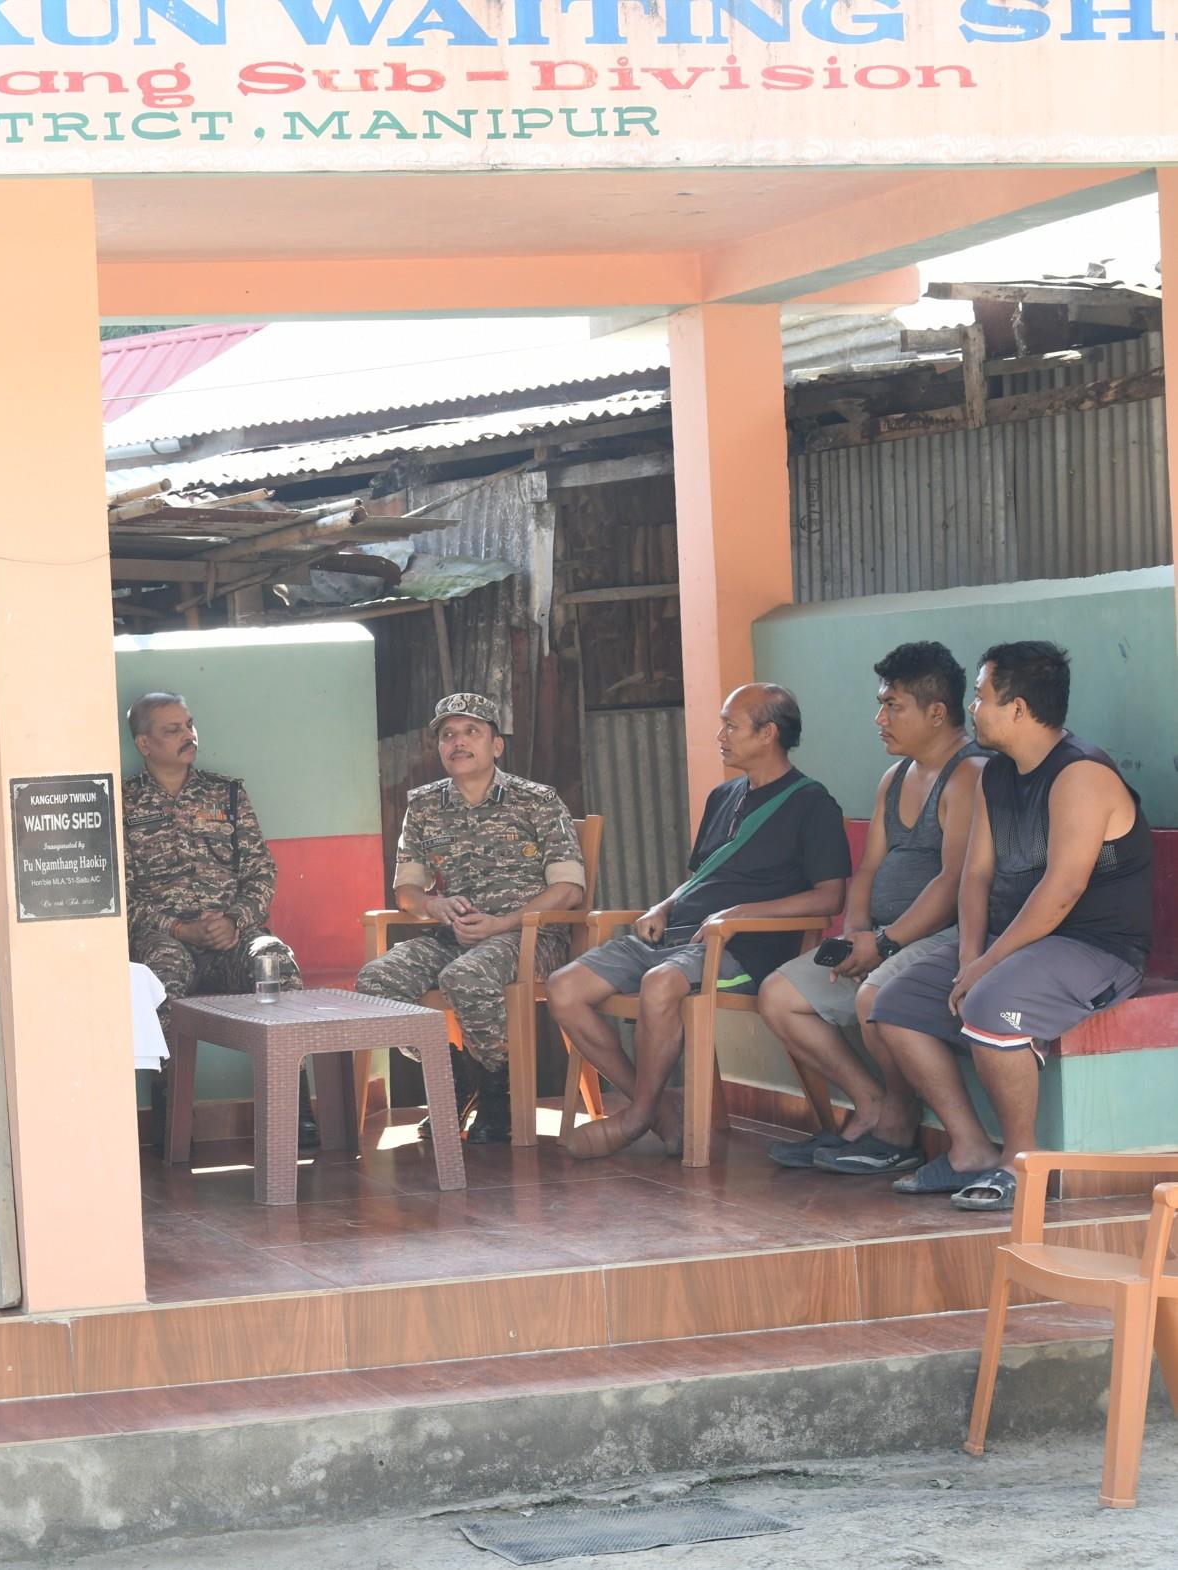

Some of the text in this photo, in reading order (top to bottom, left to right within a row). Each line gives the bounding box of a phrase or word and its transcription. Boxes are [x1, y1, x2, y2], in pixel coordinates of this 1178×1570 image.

[279, 0, 905, 46] WAITING
[959, 0, 1178, 42] SH
[282, 107, 659, 140] MANIPUR
[30, 792, 97, 805] KANGCHUP TWIKUN
[23, 811, 102, 832] WAITING SHED
[23, 855, 107, 875] Pu Ngamthang Haokip
